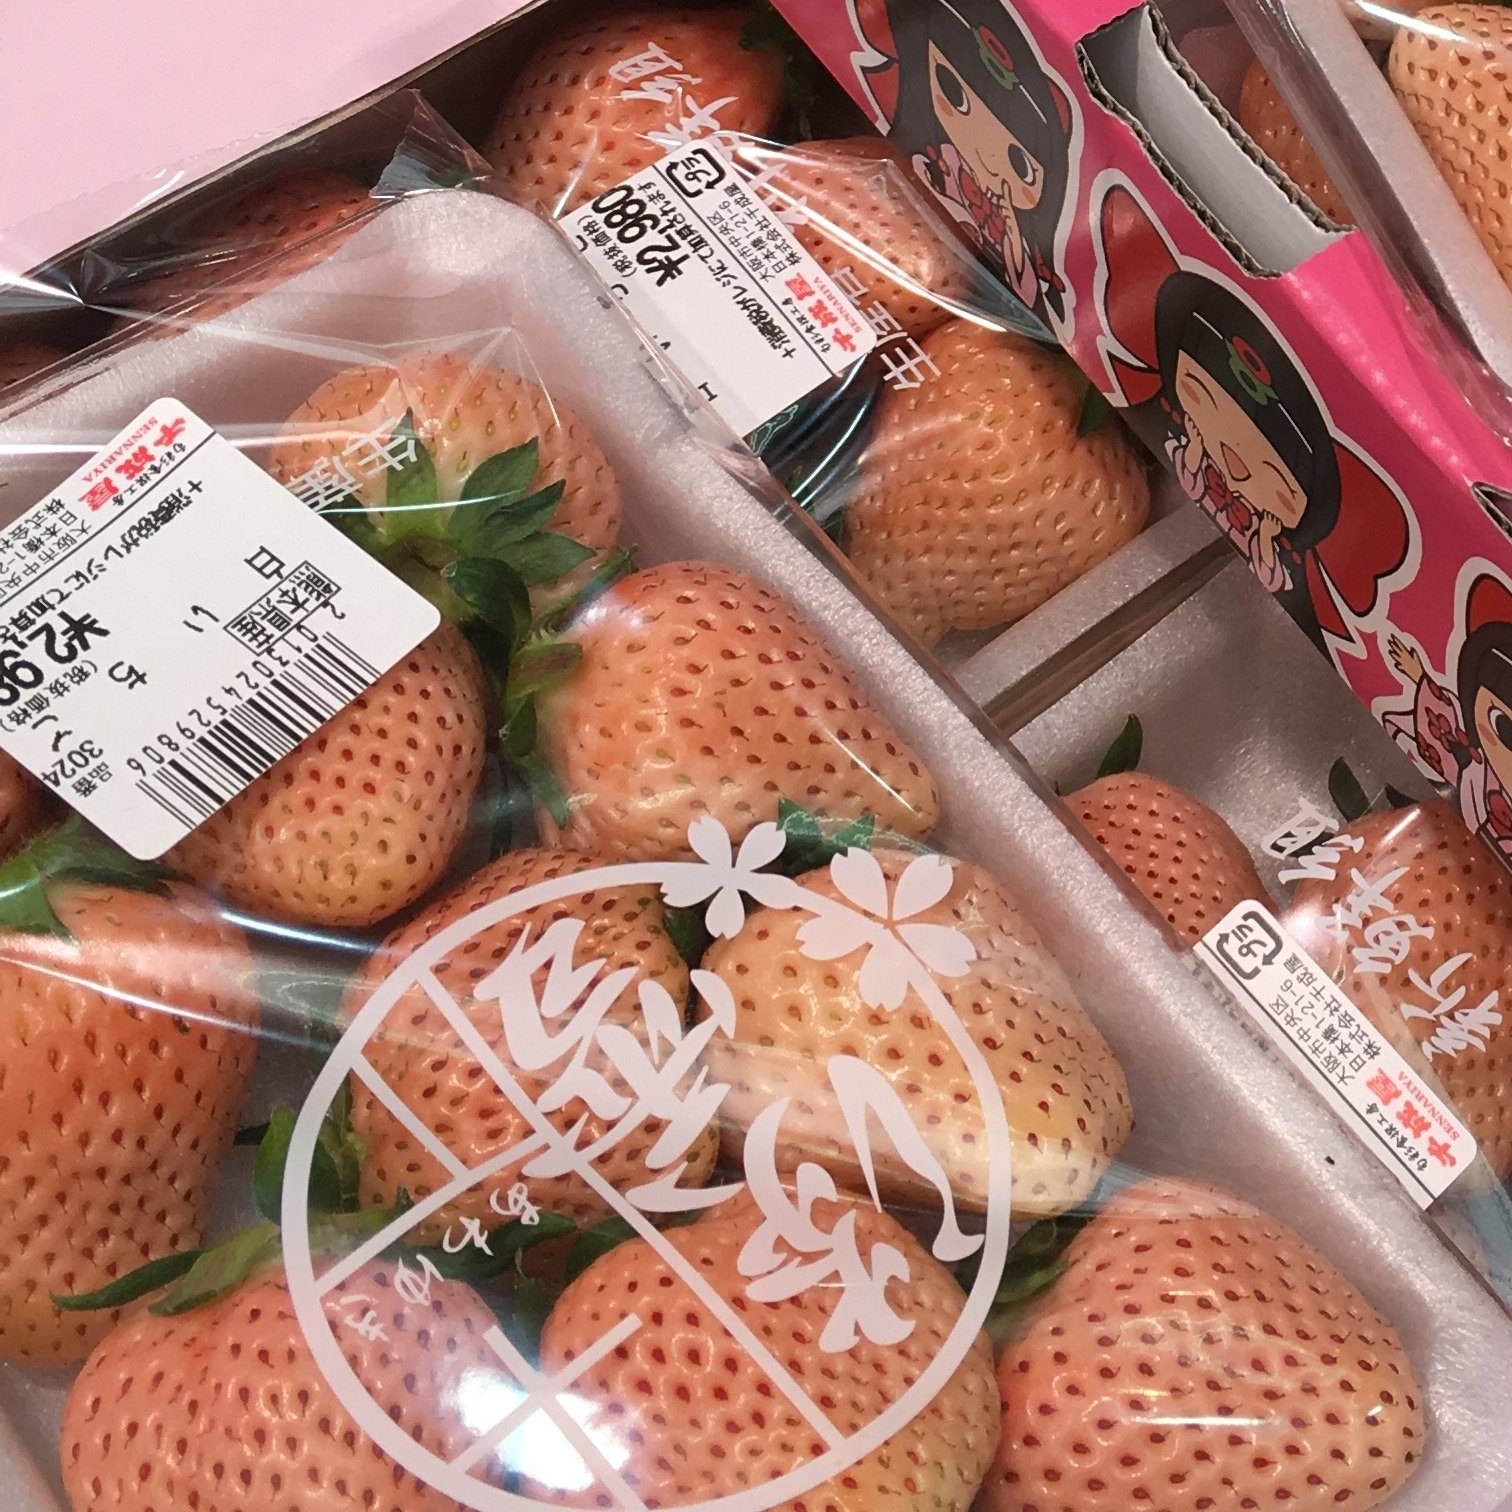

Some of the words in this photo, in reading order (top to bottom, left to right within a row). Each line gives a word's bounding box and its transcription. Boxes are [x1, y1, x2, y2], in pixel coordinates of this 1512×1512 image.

[586, 177, 701, 288] ¥2,980
[705, 208, 776, 285] 大阪市中央区
[716, 196, 788, 275] 日本橋1-21-6
[722, 180, 802, 268] 株式会社千成屋
[781, 270, 863, 358] 千成屋
[810, 274, 864, 334] SENNARIYA
[76, 408, 191, 516] 千成屋
[79, 412, 161, 489] SENNARIYA
[226, 560, 337, 655] 熊本県産
[121, 591, 347, 786] 2013024529806
[38, 734, 105, 794] 3024
[67, 758, 116, 801] 品番
[1266, 991, 1357, 1091] 大阪市中央区
[1276, 974, 1369, 1075] 日本橋1-21-6
[1280, 951, 1384, 1063] 株式会社千成屋
[1363, 1065, 1463, 1175] 千成屋
[1393, 1068, 1462, 1143] SENNARIYA
